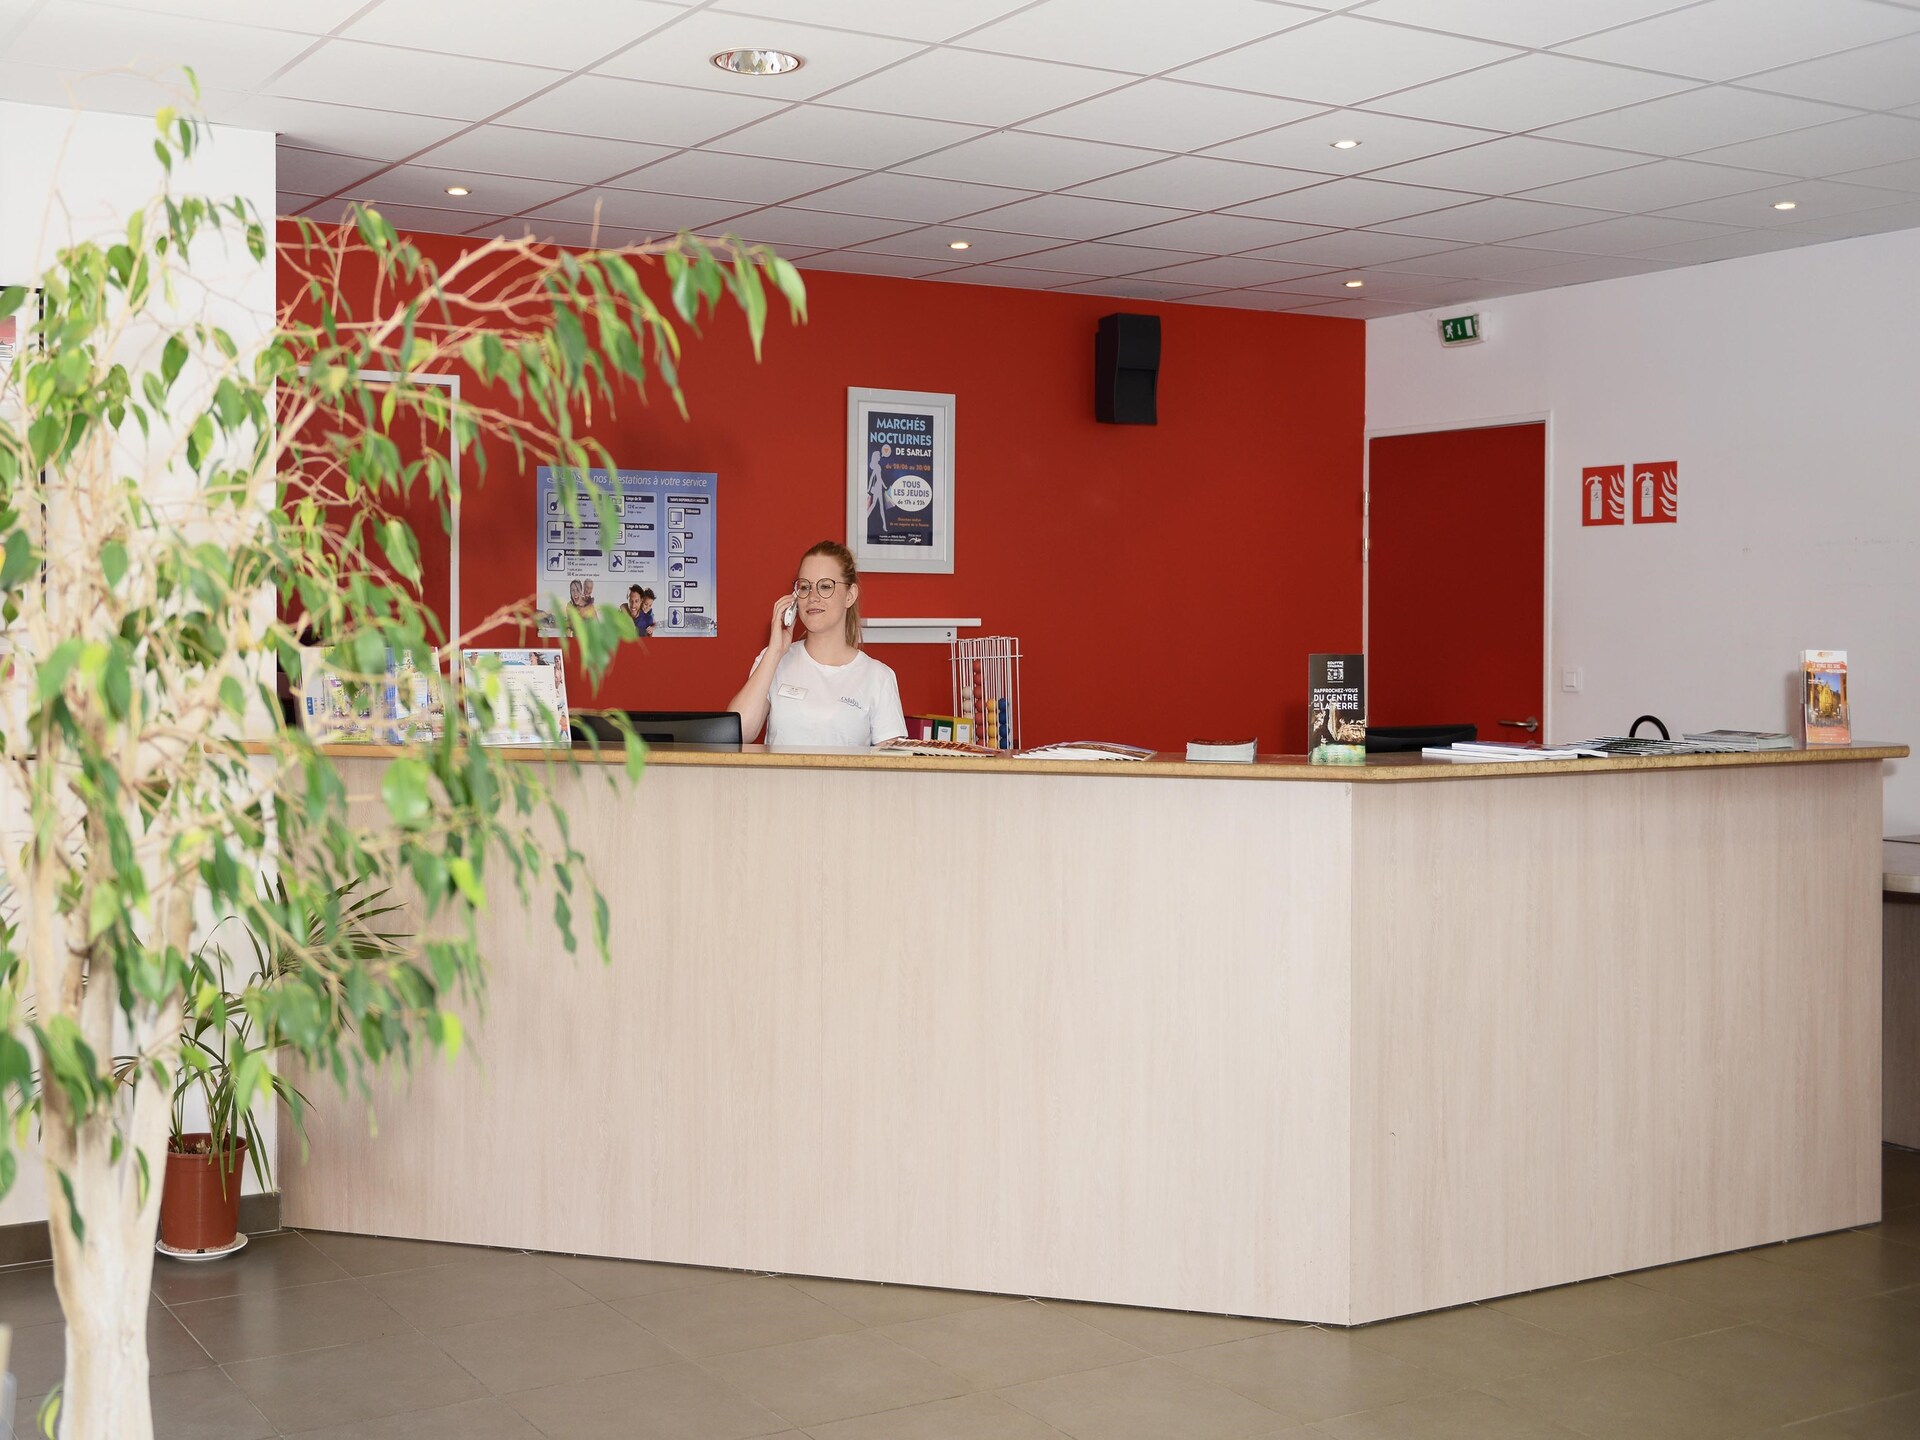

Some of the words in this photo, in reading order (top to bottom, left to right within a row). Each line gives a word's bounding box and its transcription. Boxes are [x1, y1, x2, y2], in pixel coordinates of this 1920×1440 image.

[876, 417, 926, 431] MARCHÉS
[870, 432, 932, 446] NOCTURNES
[895, 447, 905, 456] DE
[906, 448, 932, 457] SARLAT
[593, 475, 607, 484] nos
[608, 474, 652, 486] pestations
[653, 475, 659, 486] à
[661, 477, 681, 487] votre
[682, 477, 708, 487] service
[902, 480, 921, 488] TOUS
[906, 490, 930, 498] JEUDIS
[1320, 702, 1331, 710] LA
